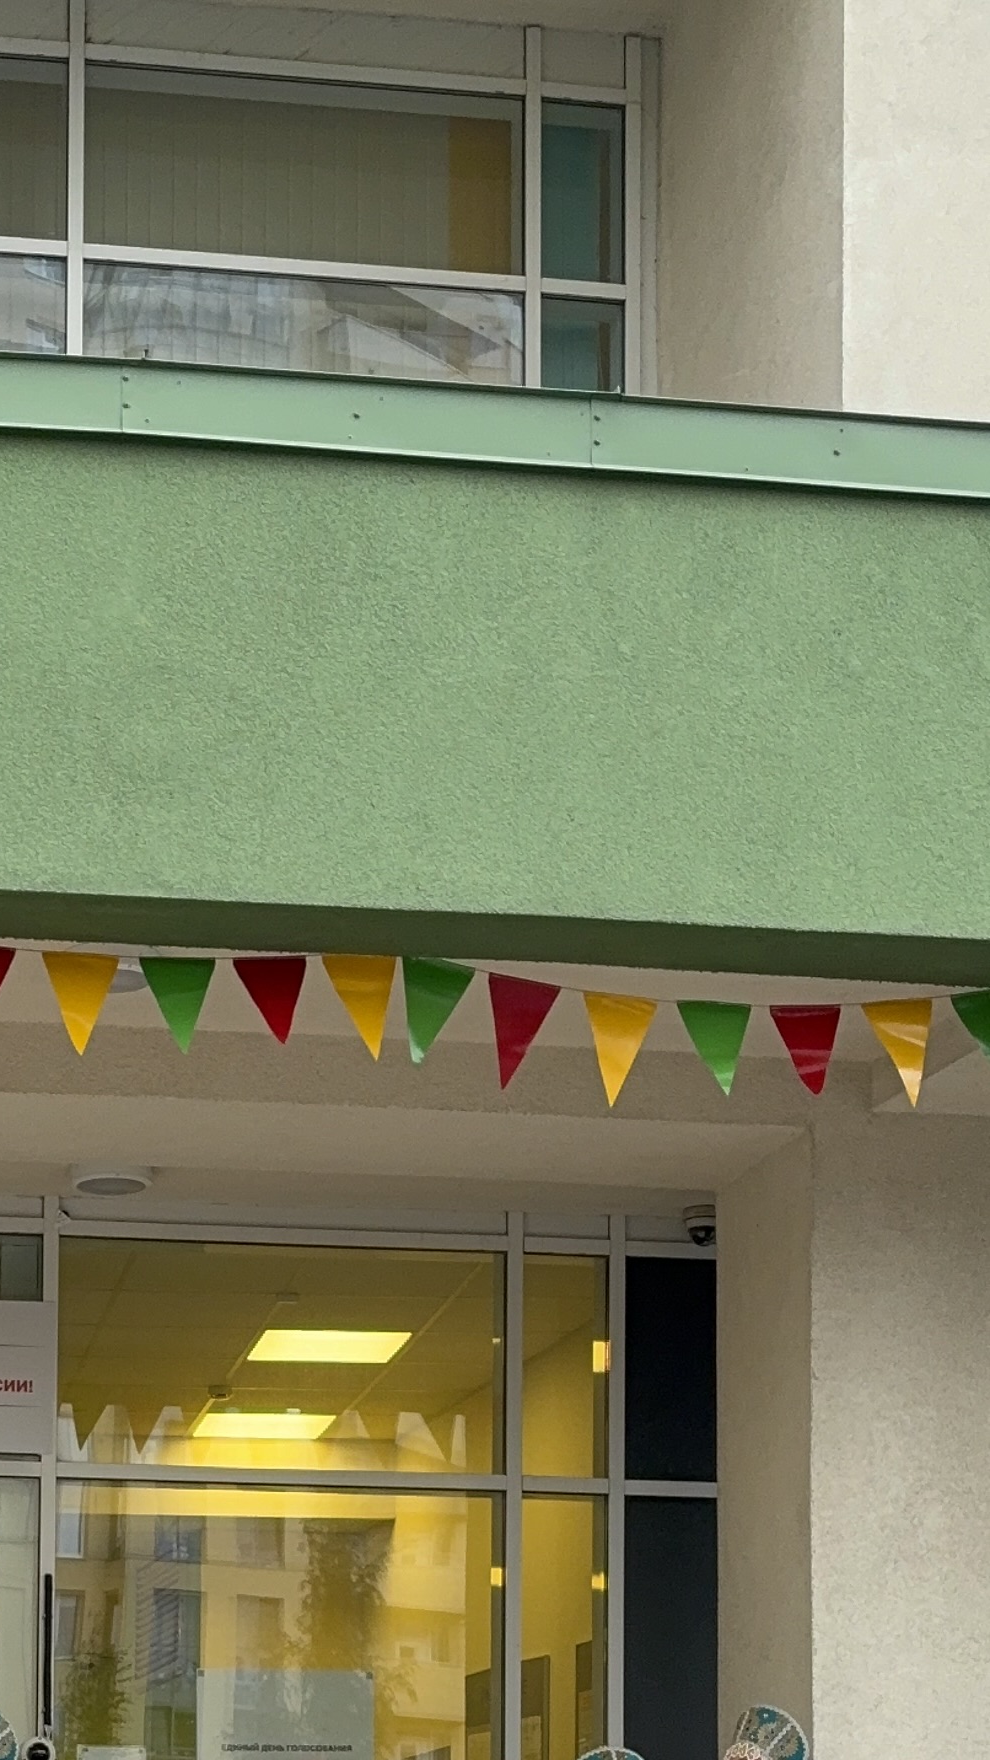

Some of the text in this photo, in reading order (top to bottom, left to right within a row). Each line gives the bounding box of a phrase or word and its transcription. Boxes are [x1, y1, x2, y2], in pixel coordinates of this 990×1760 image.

[221, 1743, 353, 1753] ЕДИНЫЙ ДЕНЬ ГОЛОСОВАНИЯ
